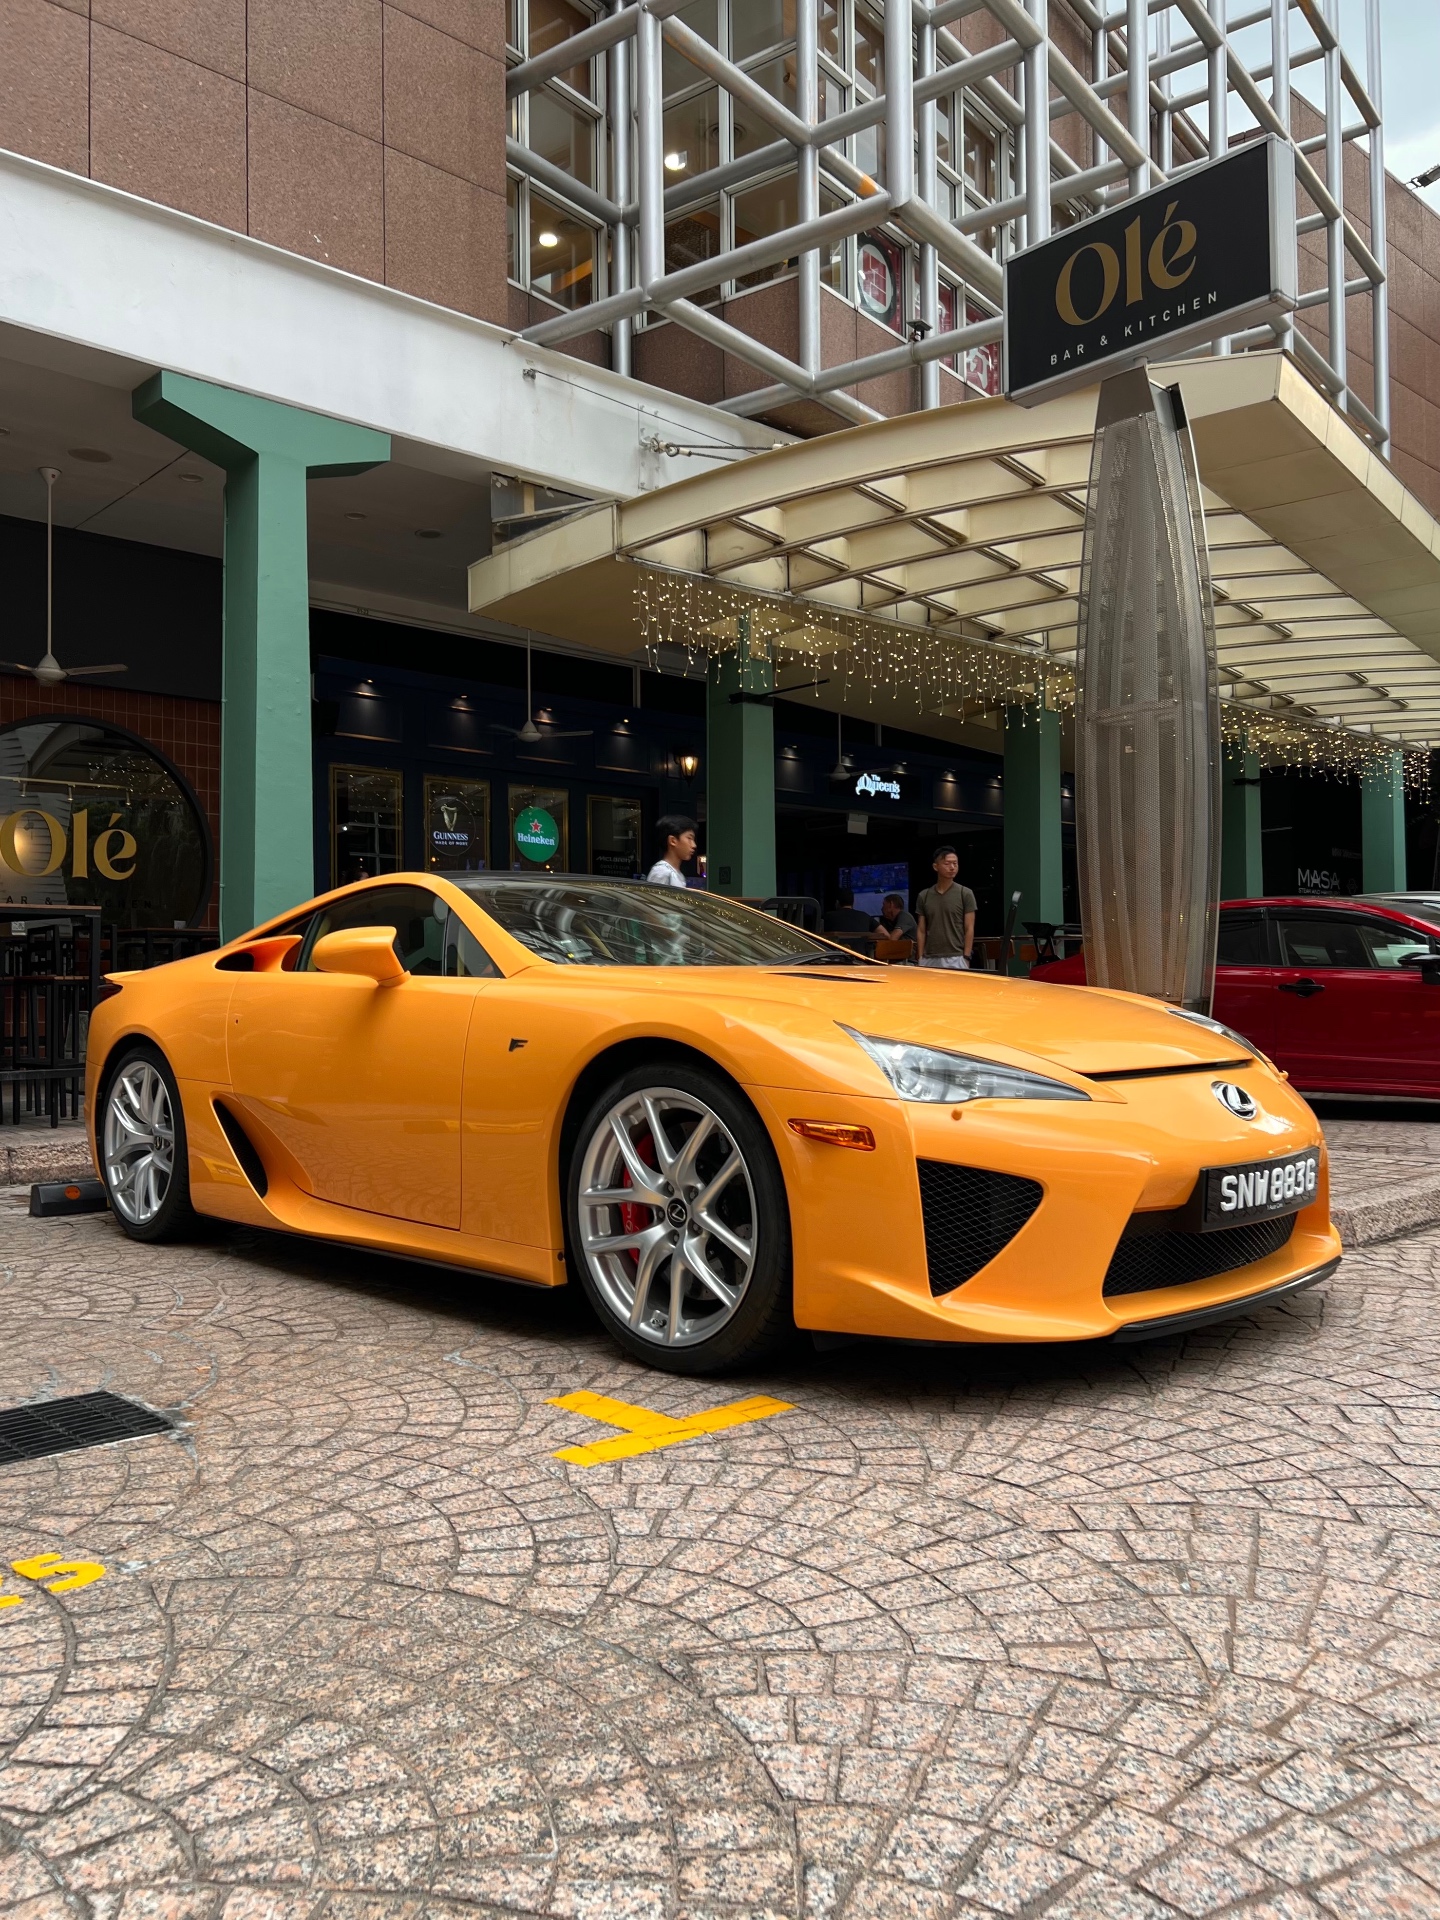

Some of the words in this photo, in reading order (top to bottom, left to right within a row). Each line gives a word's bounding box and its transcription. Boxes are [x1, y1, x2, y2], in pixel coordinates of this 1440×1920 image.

[1055, 200, 1197, 326] Olé
[1050, 344, 1084, 366] BAR
[1099, 335, 1109, 347] &
[1124, 291, 1218, 338] KITCHEN
[0, 808, 138, 881] Olé
[517, 832, 556, 846] Heineken
[1297, 867, 1341, 890] MASA
